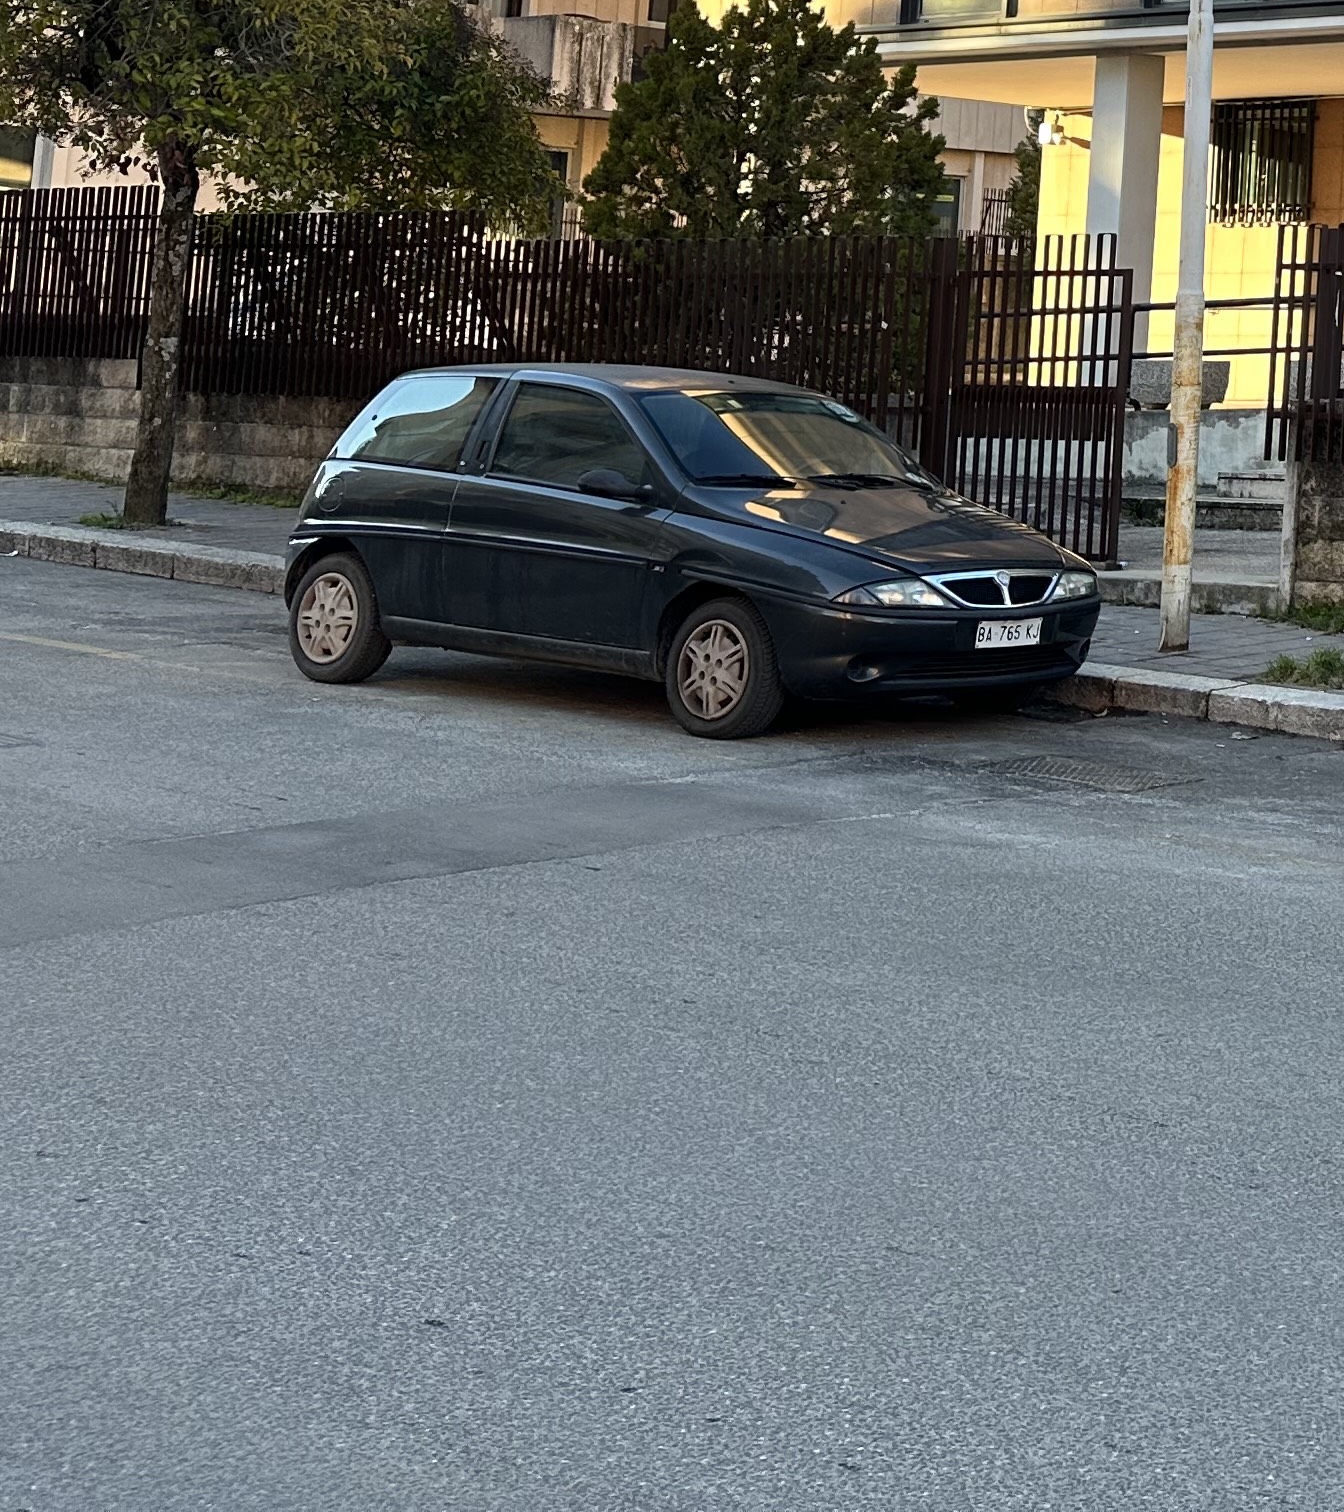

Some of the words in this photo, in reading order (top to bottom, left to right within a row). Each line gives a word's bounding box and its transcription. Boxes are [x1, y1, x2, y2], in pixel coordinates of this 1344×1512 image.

[978, 626, 992, 642] BA
[1000, 625, 1022, 641] 765
[1025, 623, 1040, 639] KJ
